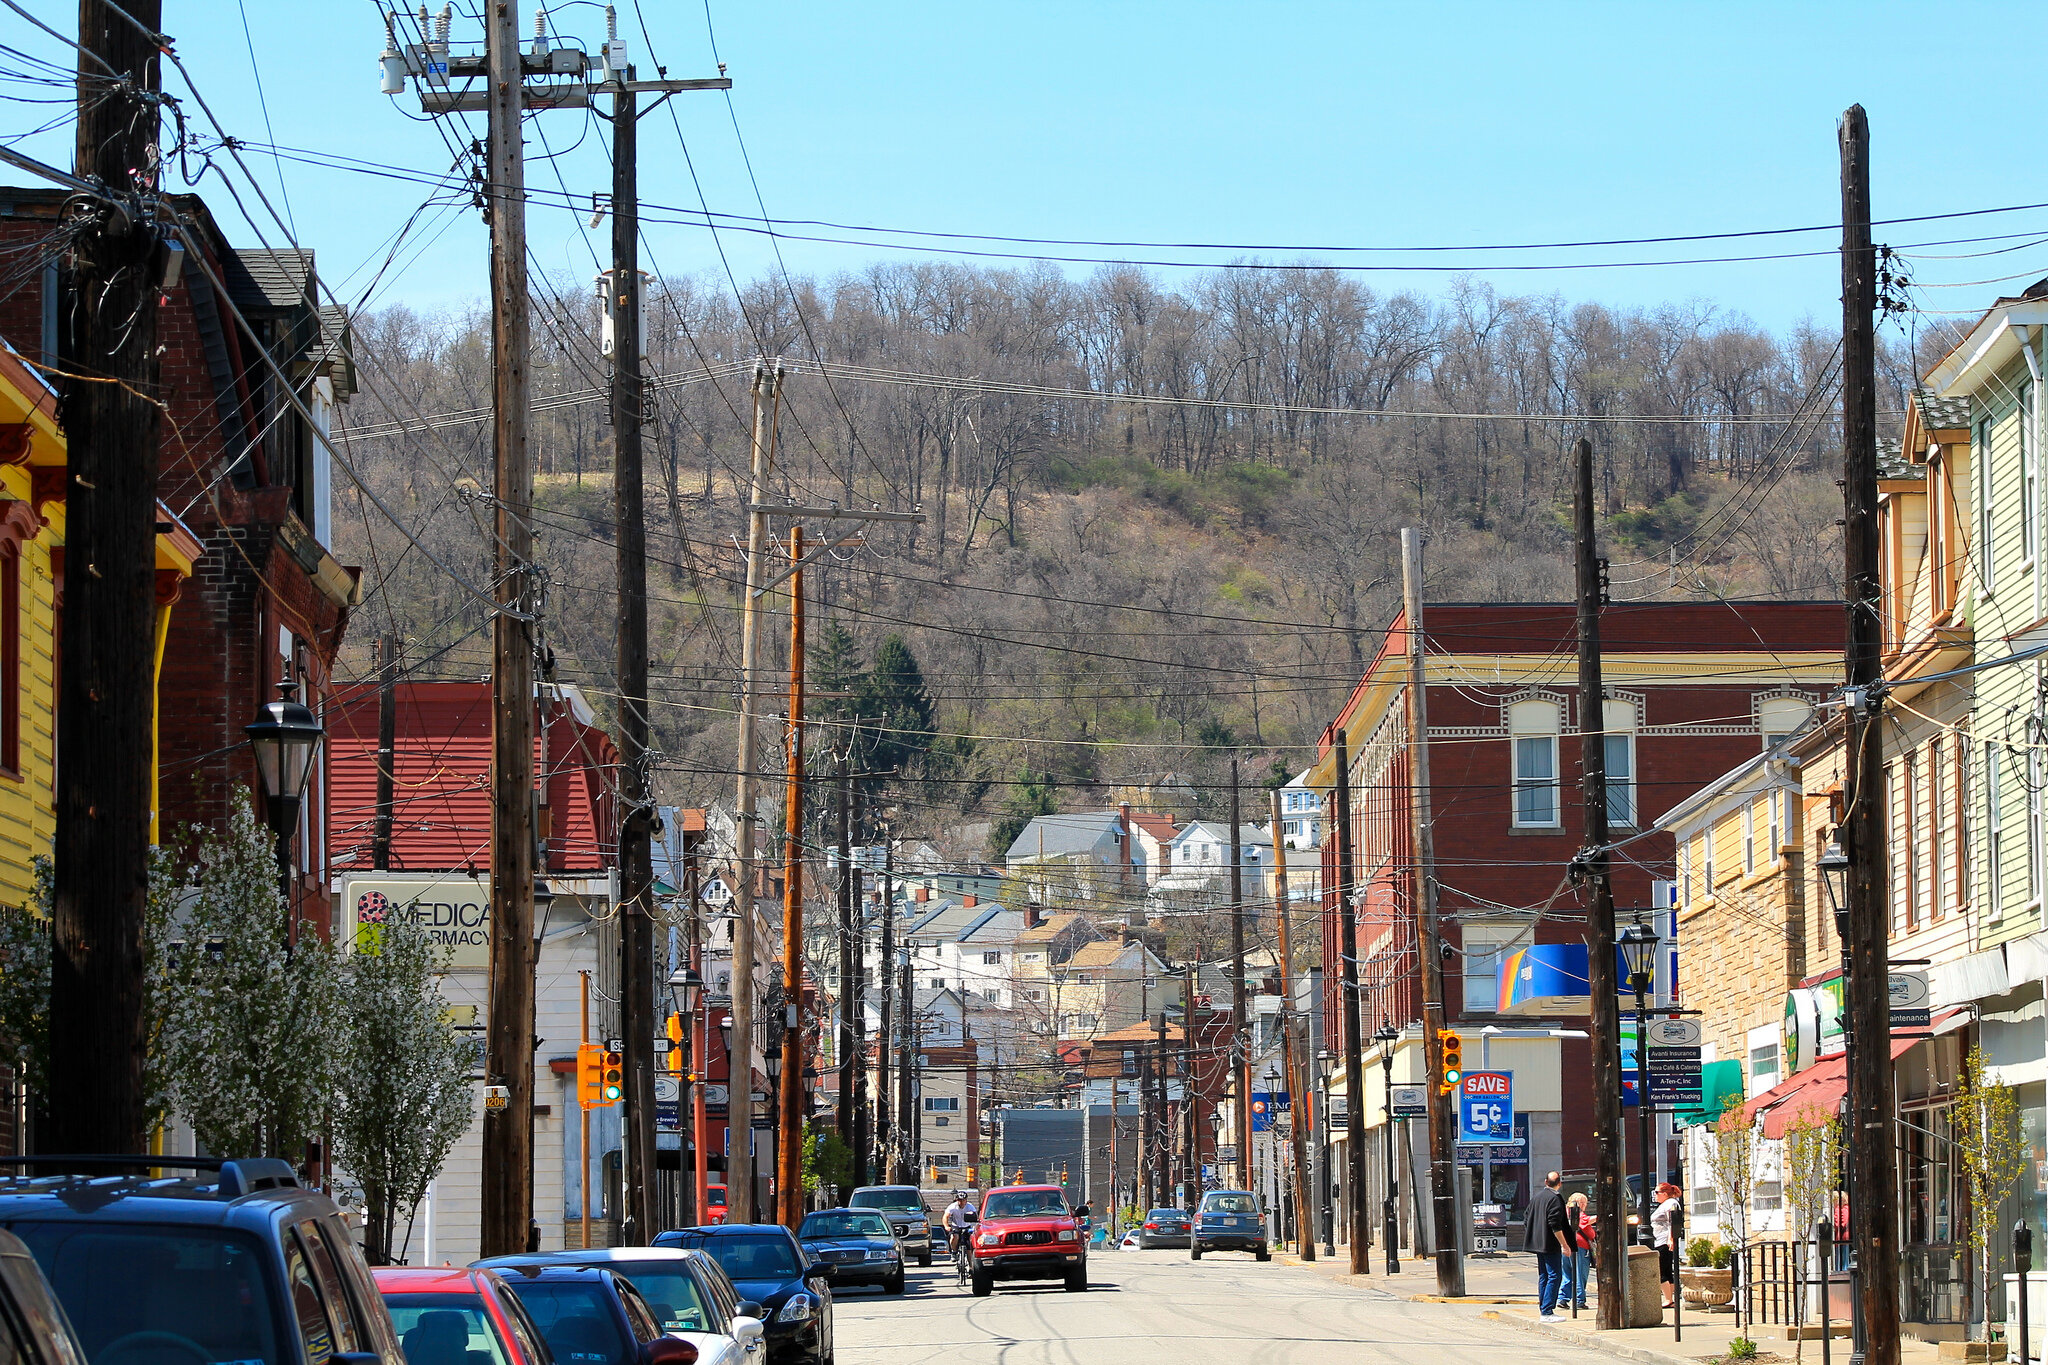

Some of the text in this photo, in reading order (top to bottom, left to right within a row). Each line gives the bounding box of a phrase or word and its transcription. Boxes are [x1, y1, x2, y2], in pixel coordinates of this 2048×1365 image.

[391, 902, 490, 928] MEDICA
[1890, 1013, 1929, 1022] aintenance
[1680, 1064, 1701, 1072] Catering
[1467, 1076, 1505, 1092] SAVE
[1477, 1239, 1498, 1249] 3.19
